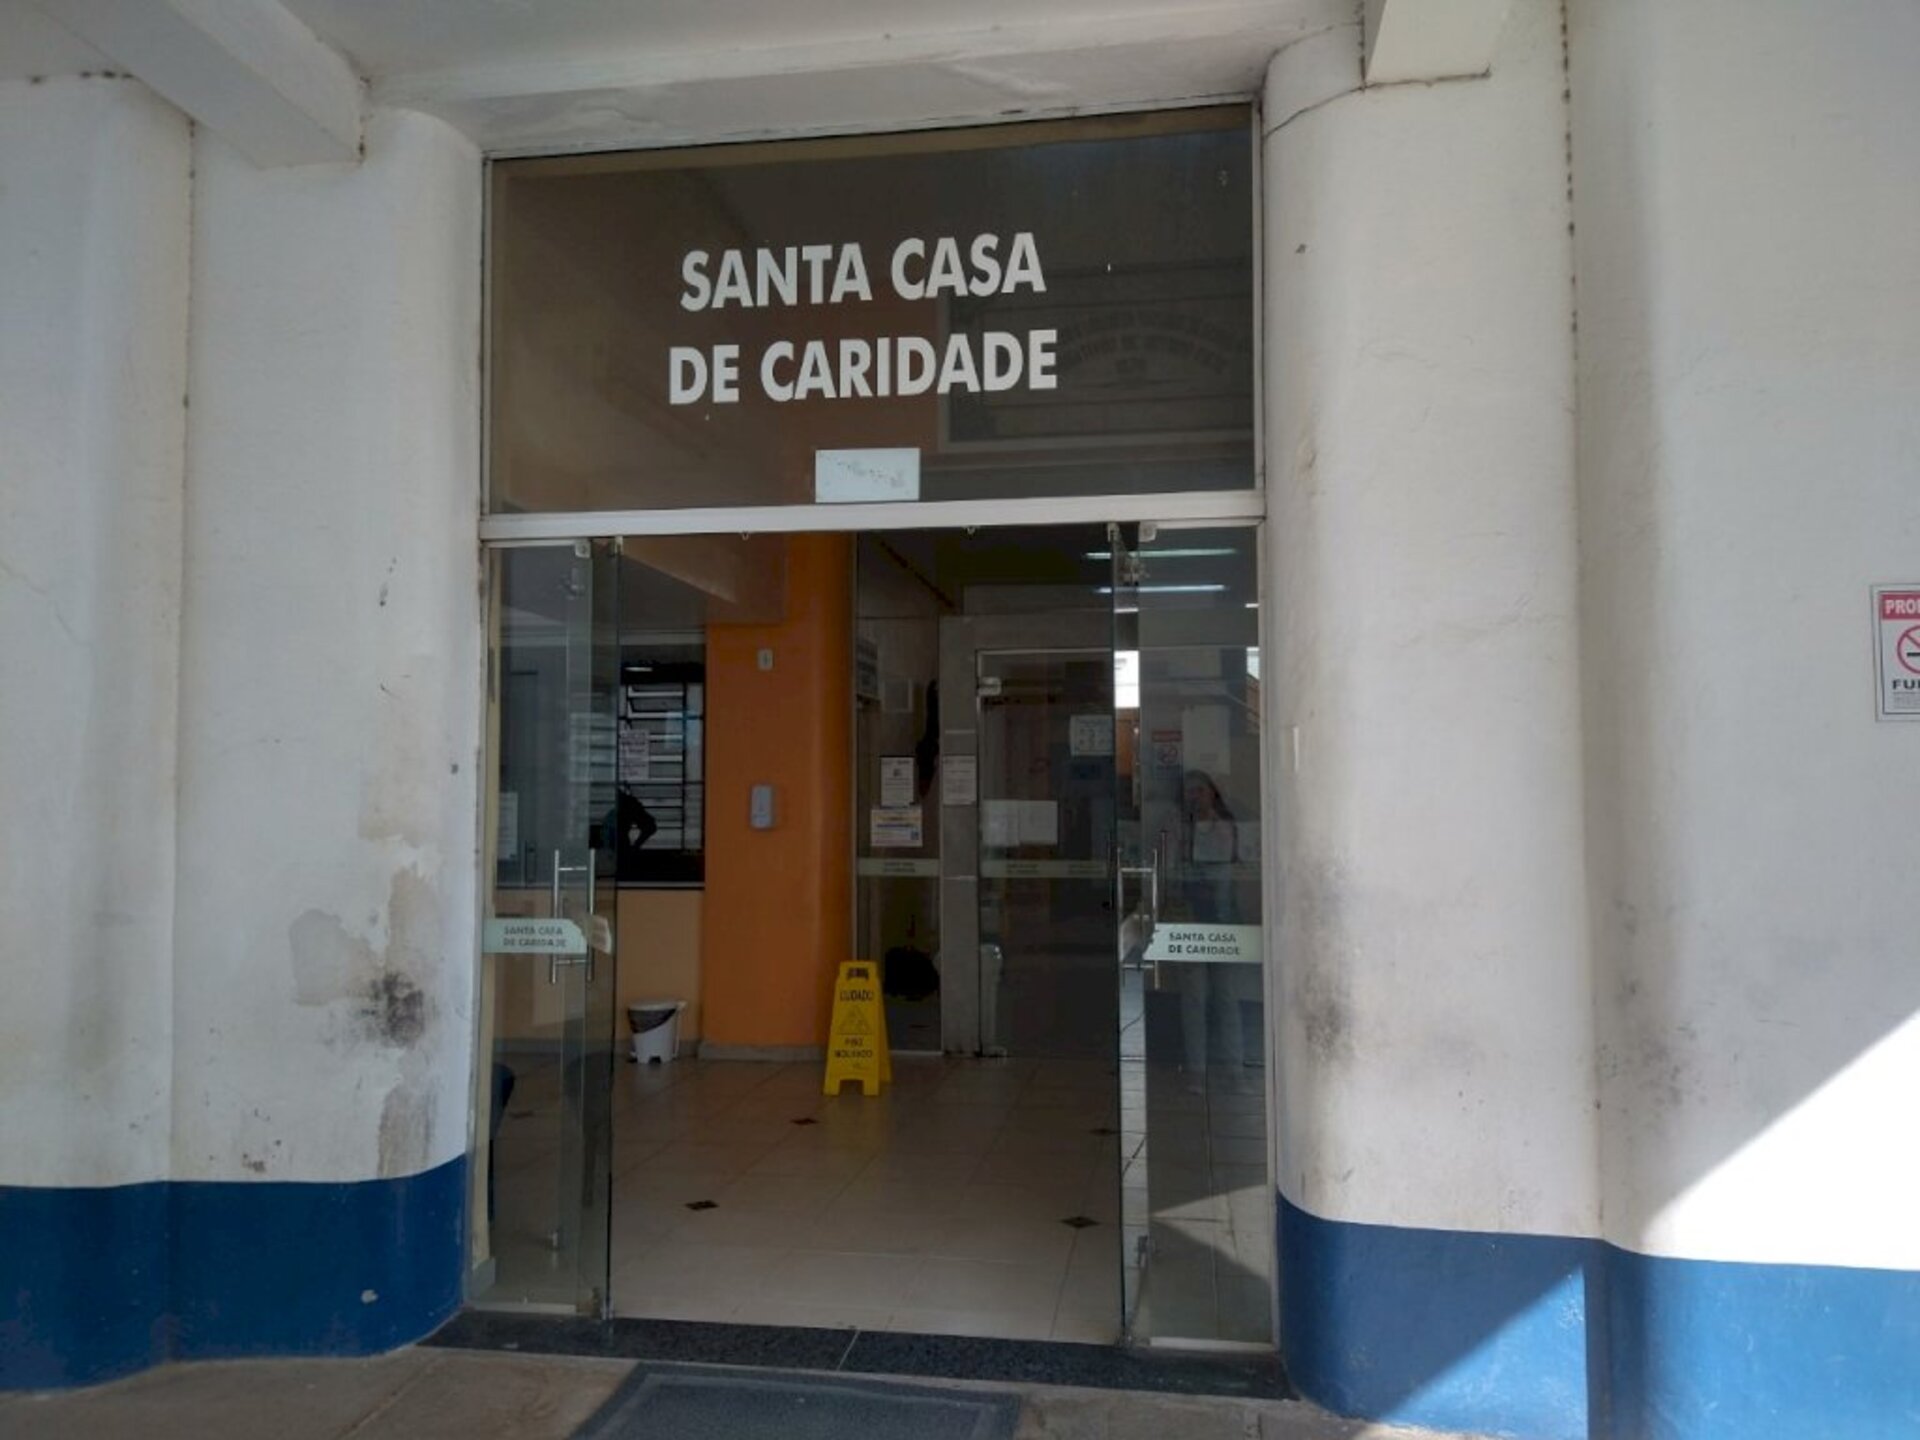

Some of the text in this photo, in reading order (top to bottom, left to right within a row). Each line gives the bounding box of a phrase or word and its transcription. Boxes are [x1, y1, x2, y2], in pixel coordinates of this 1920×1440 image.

[680, 232, 1047, 312] SANTA CASA
[669, 345, 740, 405] DE
[760, 329, 1058, 402] CARIDADE
[503, 925, 536, 935] SANTA
[503, 937, 515, 947] DE
[1168, 931, 1237, 943] SANTA CASA
[1168, 944, 1240, 956] DE CARIDADE
